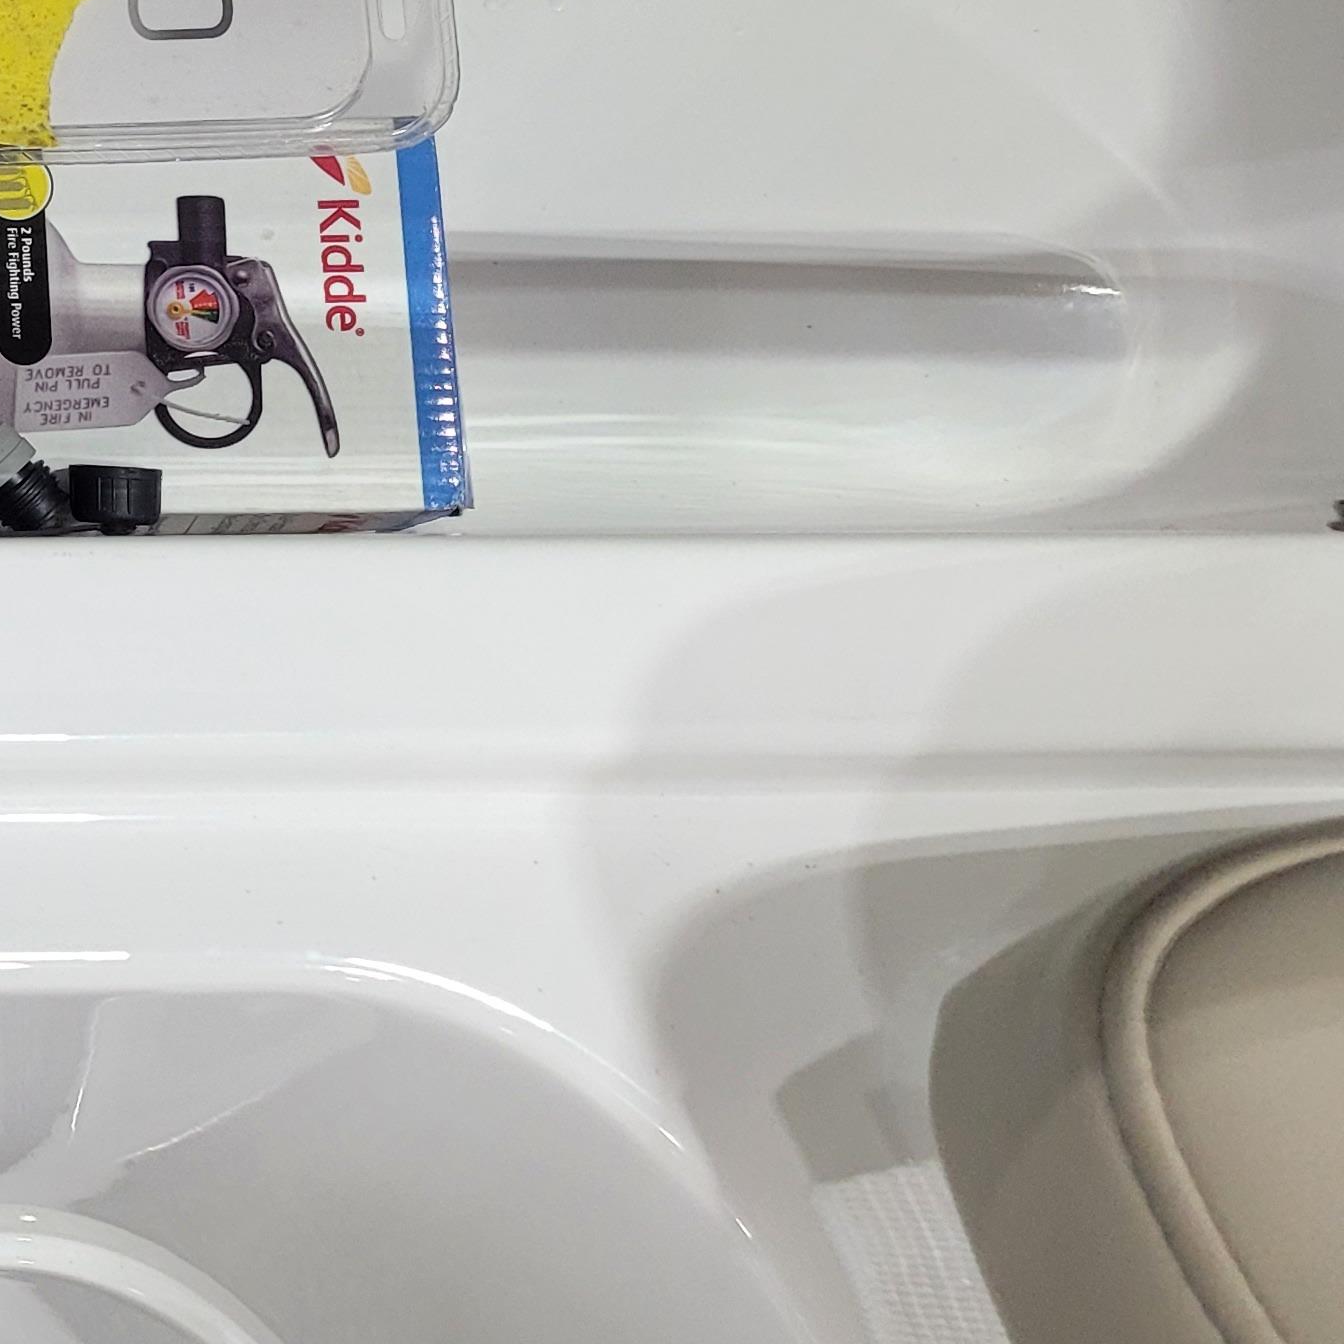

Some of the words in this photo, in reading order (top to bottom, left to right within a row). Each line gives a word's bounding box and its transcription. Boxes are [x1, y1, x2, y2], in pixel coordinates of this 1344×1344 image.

[6, 227, 19, 249] Fire
[20, 227, 33, 235] 2
[21, 237, 35, 283] Pounds
[6, 252, 23, 300] Fighting
[10, 303, 23, 340] Power
[25, 365, 84, 382] REMOVE
[92, 363, 112, 376] TO
[35, 380, 58, 393] PIN
[67, 377, 101, 390] PULL
[23, 395, 110, 414] EMERGENCY
[40, 413, 71, 426] FIRE
[78, 411, 93, 423] IN
